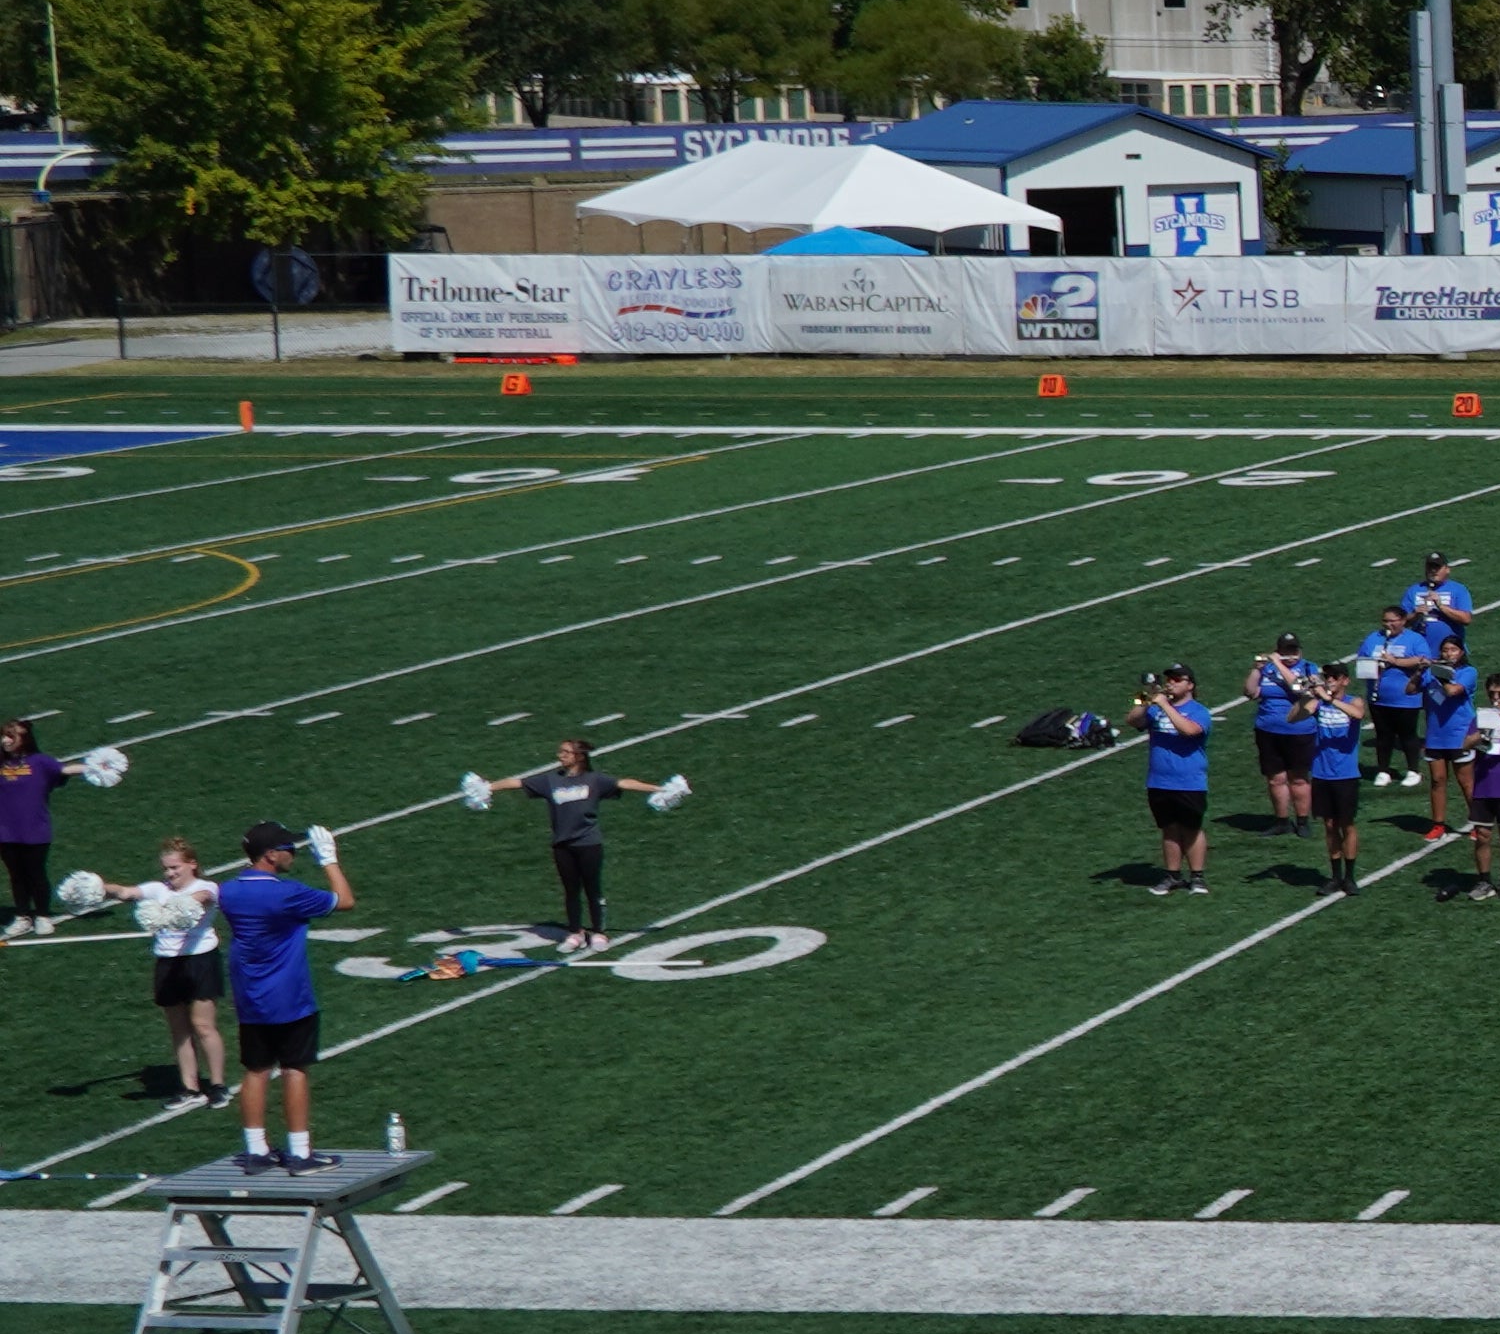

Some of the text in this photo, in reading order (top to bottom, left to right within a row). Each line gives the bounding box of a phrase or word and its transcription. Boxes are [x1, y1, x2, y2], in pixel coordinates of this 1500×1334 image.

[1155, 213, 1226, 232] SYCAMORES
[401, 276, 571, 303] Tribune-Star
[1052, 273, 1097, 320] 2
[1218, 290, 1300, 308] THSB
[402, 312, 569, 324] OFFICIAL GAME DAY PUBLISHER
[1395, 307, 1485, 320] CHEVROLET
[419, 328, 552, 339] OF SYCAMORE FOOTBALL
[1020, 323, 1097, 338] WTWO
[506, 374, 519, 392] G
[1042, 376, 1057, 394] 10
[1455, 395, 1474, 415] 20
[335, 924, 827, 982] 30
